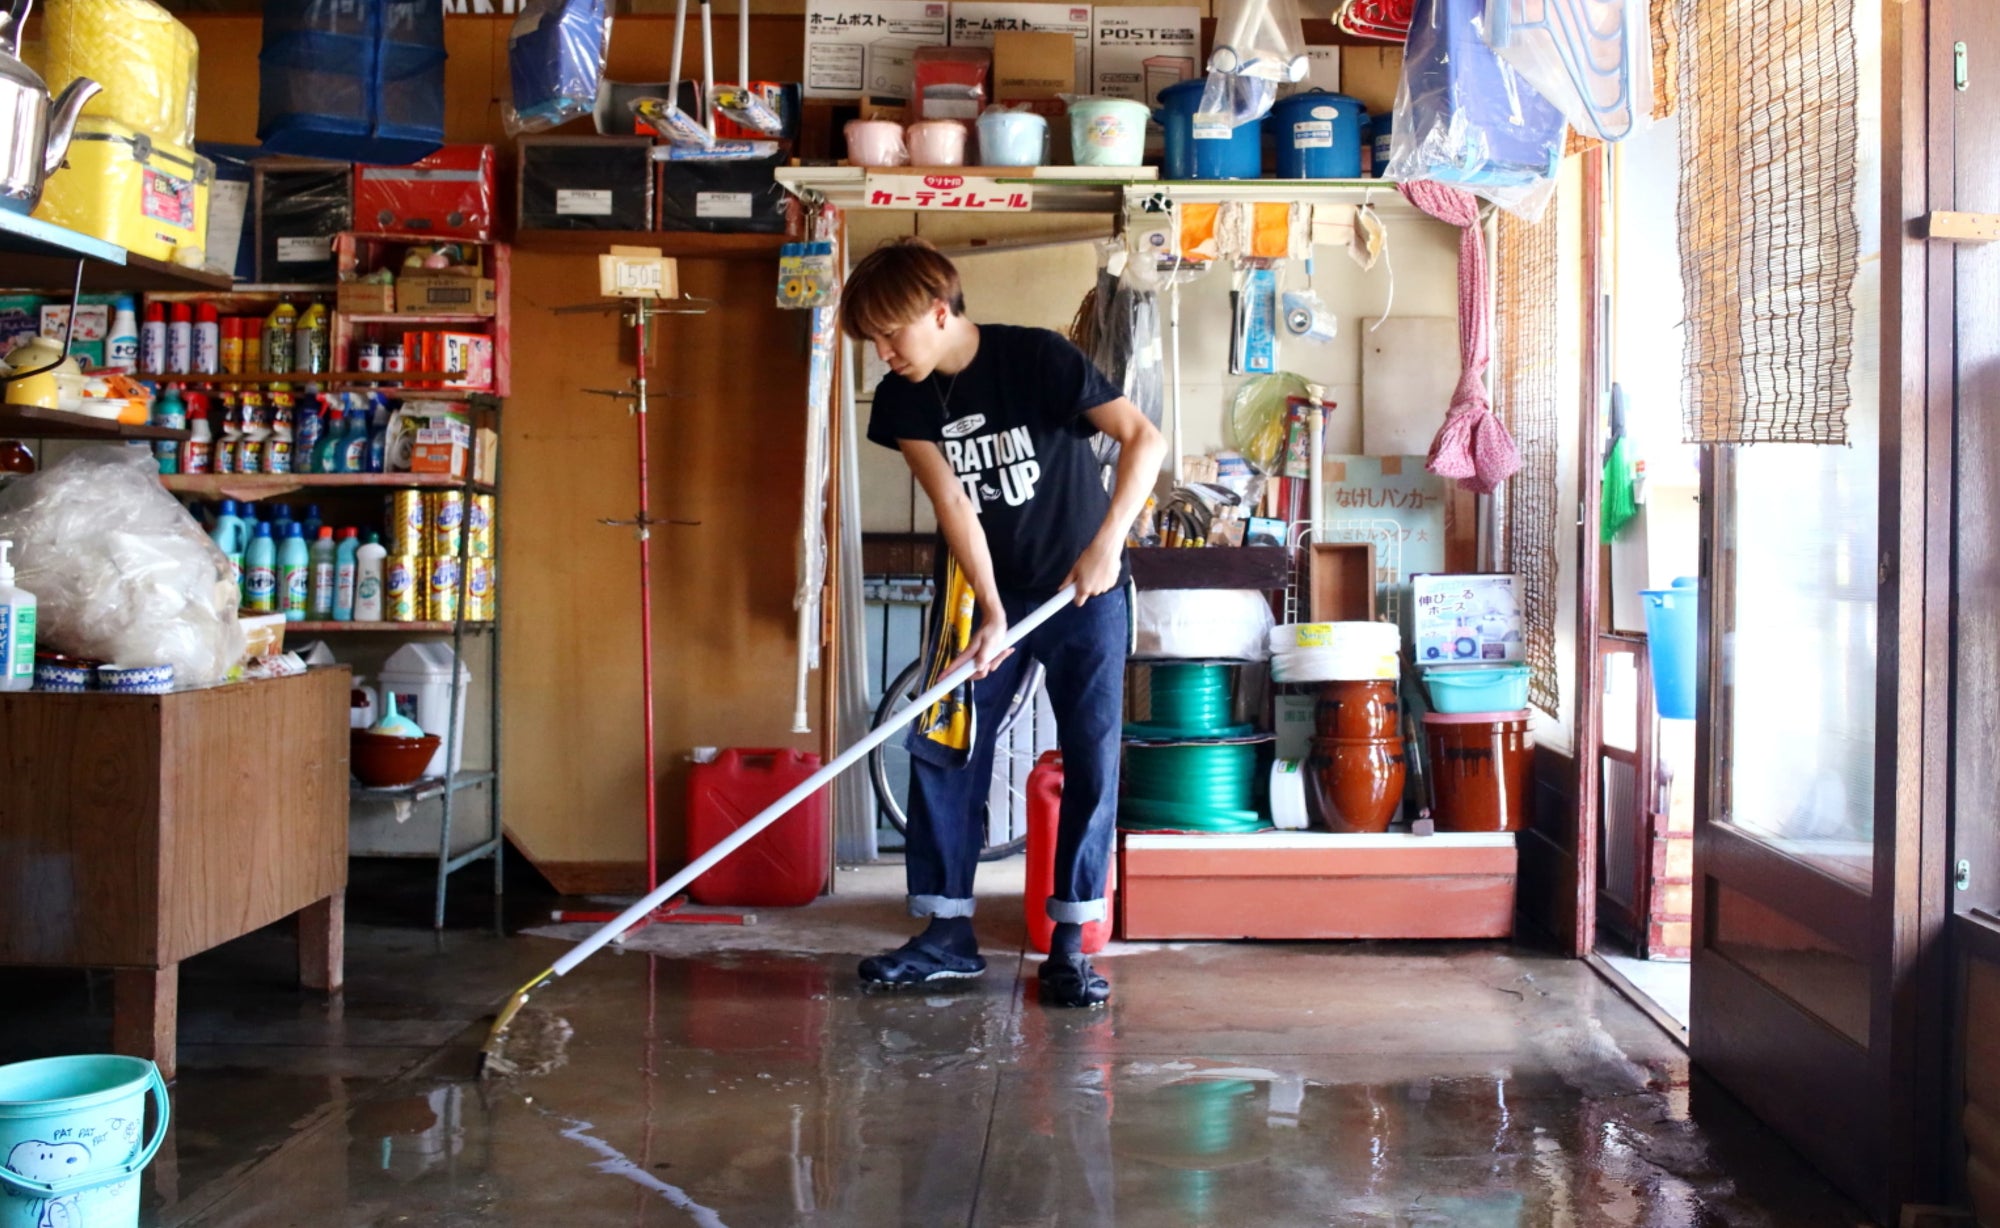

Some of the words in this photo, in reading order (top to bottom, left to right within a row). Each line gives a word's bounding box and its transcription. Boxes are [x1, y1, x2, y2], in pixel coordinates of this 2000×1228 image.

[810, 13, 887, 27] ホームポスト
[955, 18, 1031, 31] ホームポスト
[1100, 28, 1158, 39] POST
[871, 190, 1029, 208] カーテンレール
[945, 418, 982, 434] KEEN
[940, 425, 1035, 473] RATION
[958, 473, 983, 514] T
[999, 460, 1041, 507] UP
[1336, 487, 1438, 509] なげしハンガー
[1428, 602, 1466, 616] ホース
[53, 1128, 73, 1140] PAT
[78, 1128, 96, 1139] PAT
